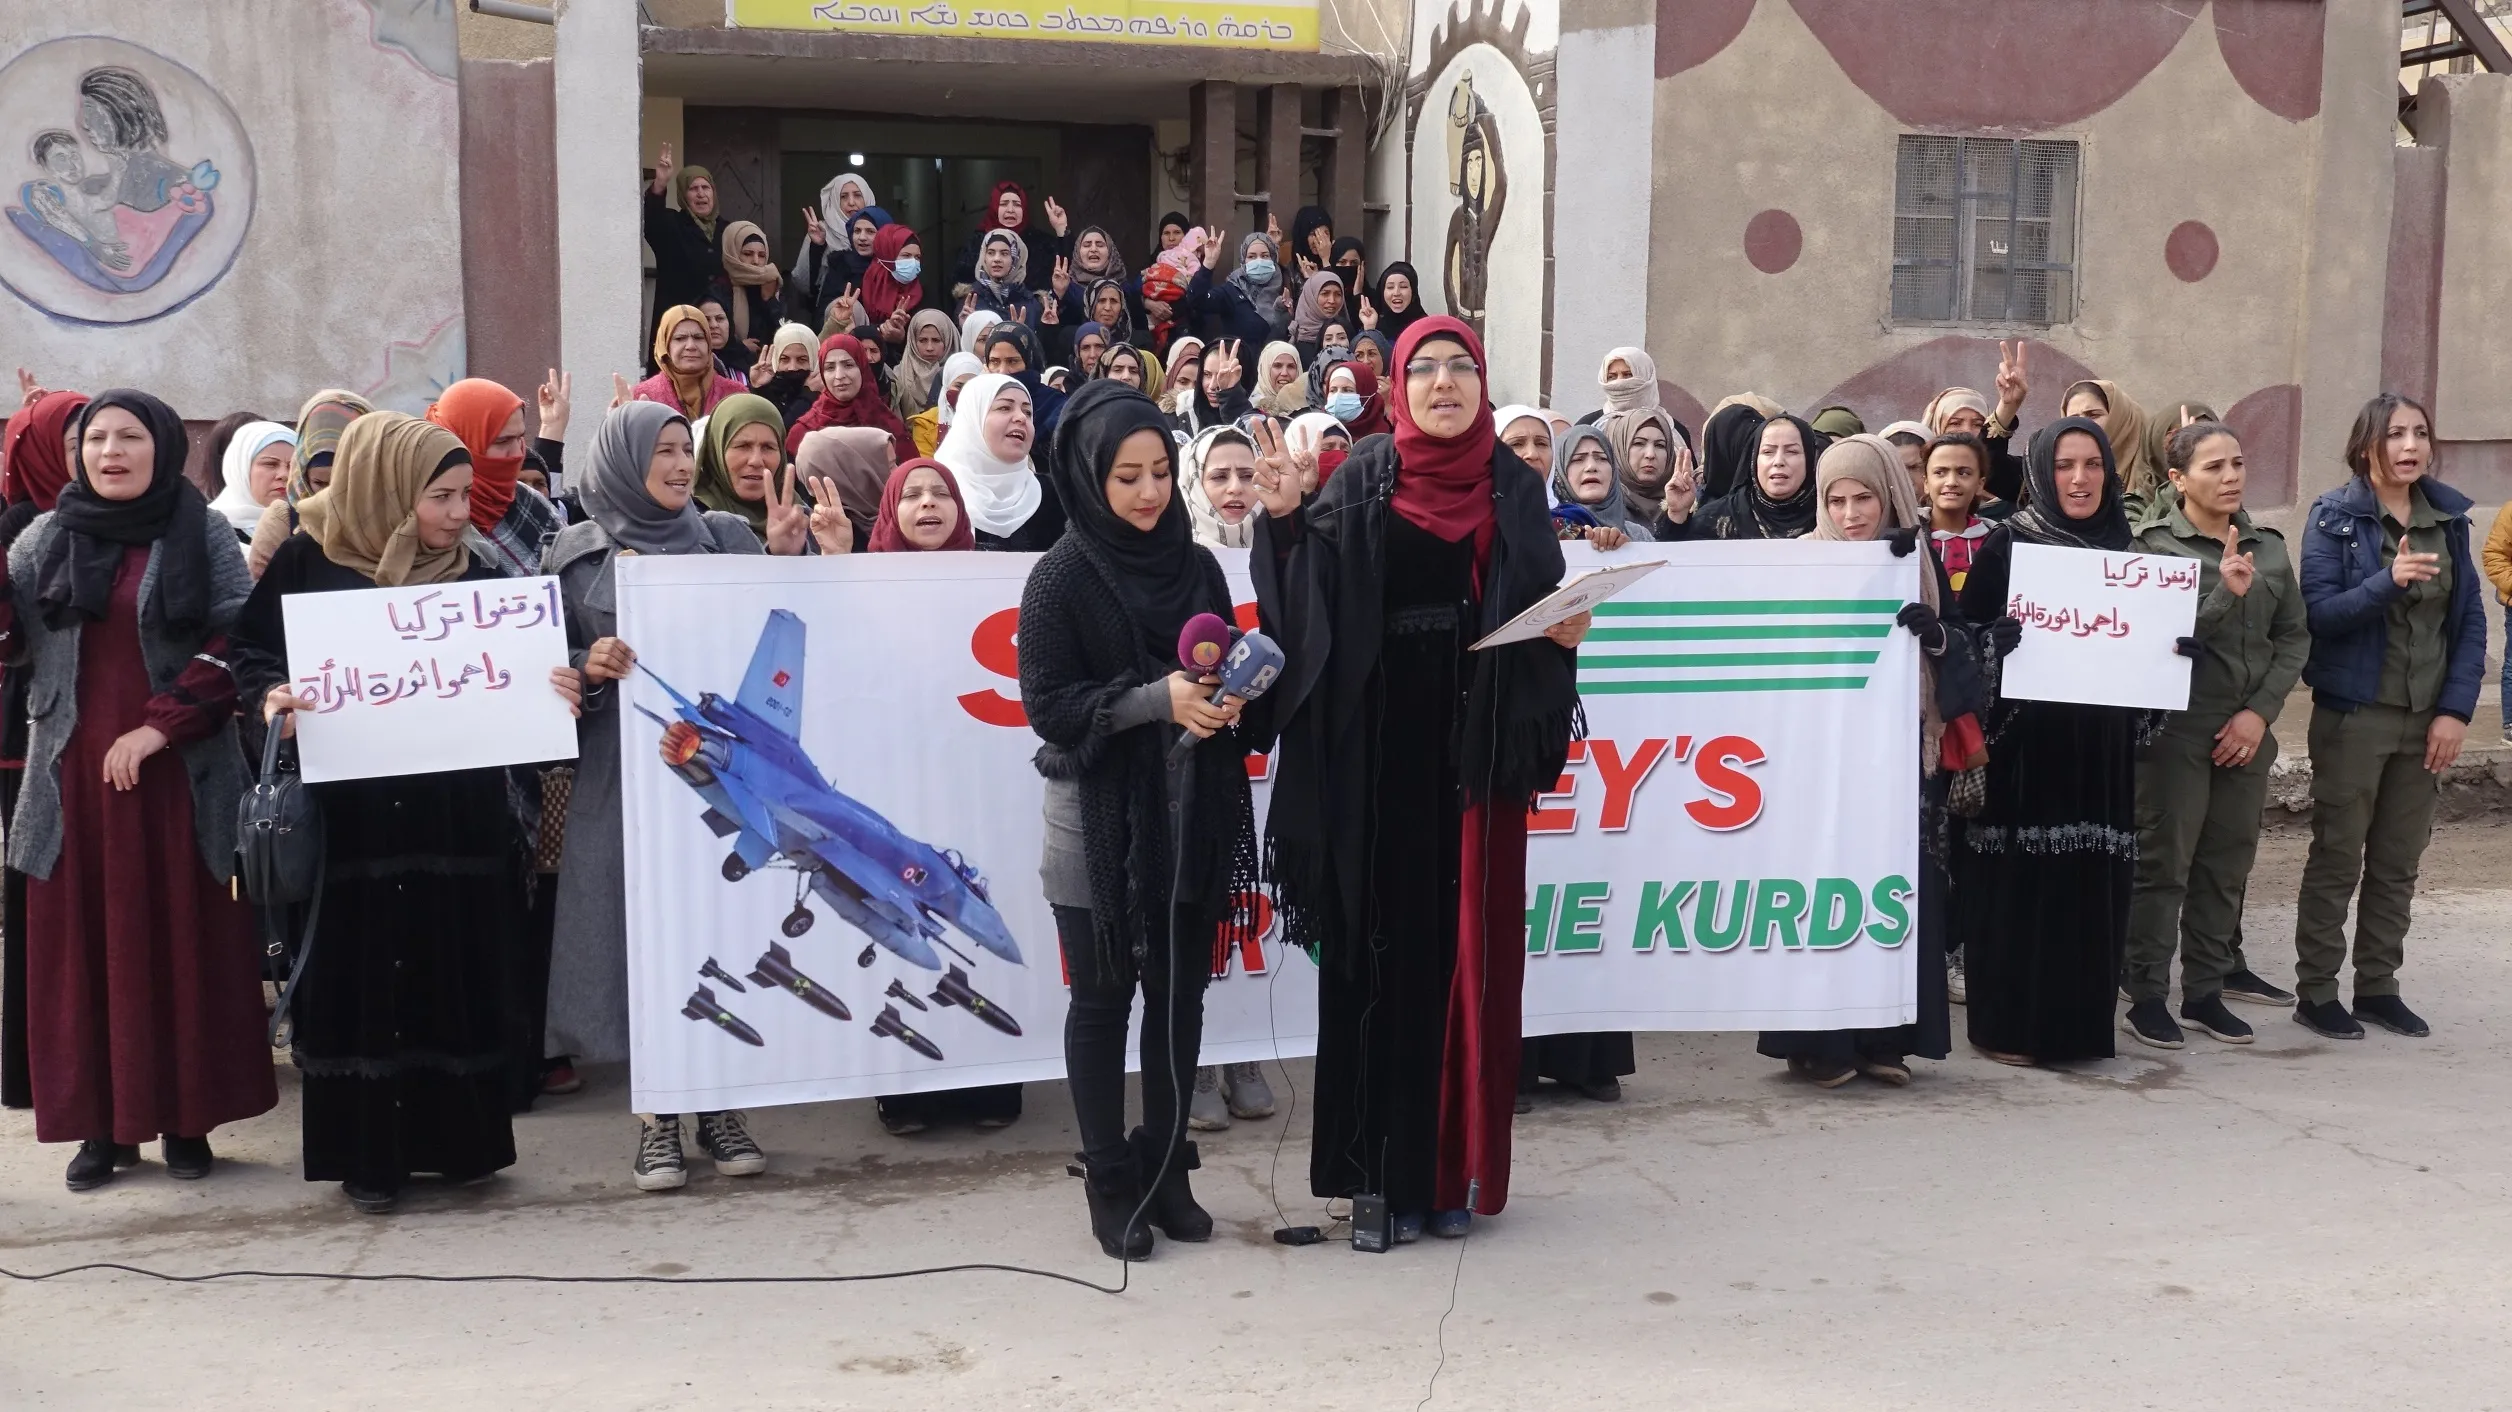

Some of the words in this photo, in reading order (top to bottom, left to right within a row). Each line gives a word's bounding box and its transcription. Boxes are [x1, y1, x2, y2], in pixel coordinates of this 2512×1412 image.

[2103, 556, 2149, 588] تركيا
[2156, 562, 2197, 592] أوقفوا
[387, 590, 465, 641] تركيا
[473, 580, 560, 629] أوقفوا
[2070, 606, 2131, 639] واحموا
[367, 659, 429, 706] ثورة
[430, 651, 512, 699] واحموا
[1526, 734, 1768, 834] EY'S
[1524, 880, 1611, 956] HE
[1631, 873, 1916, 954] KURDS
